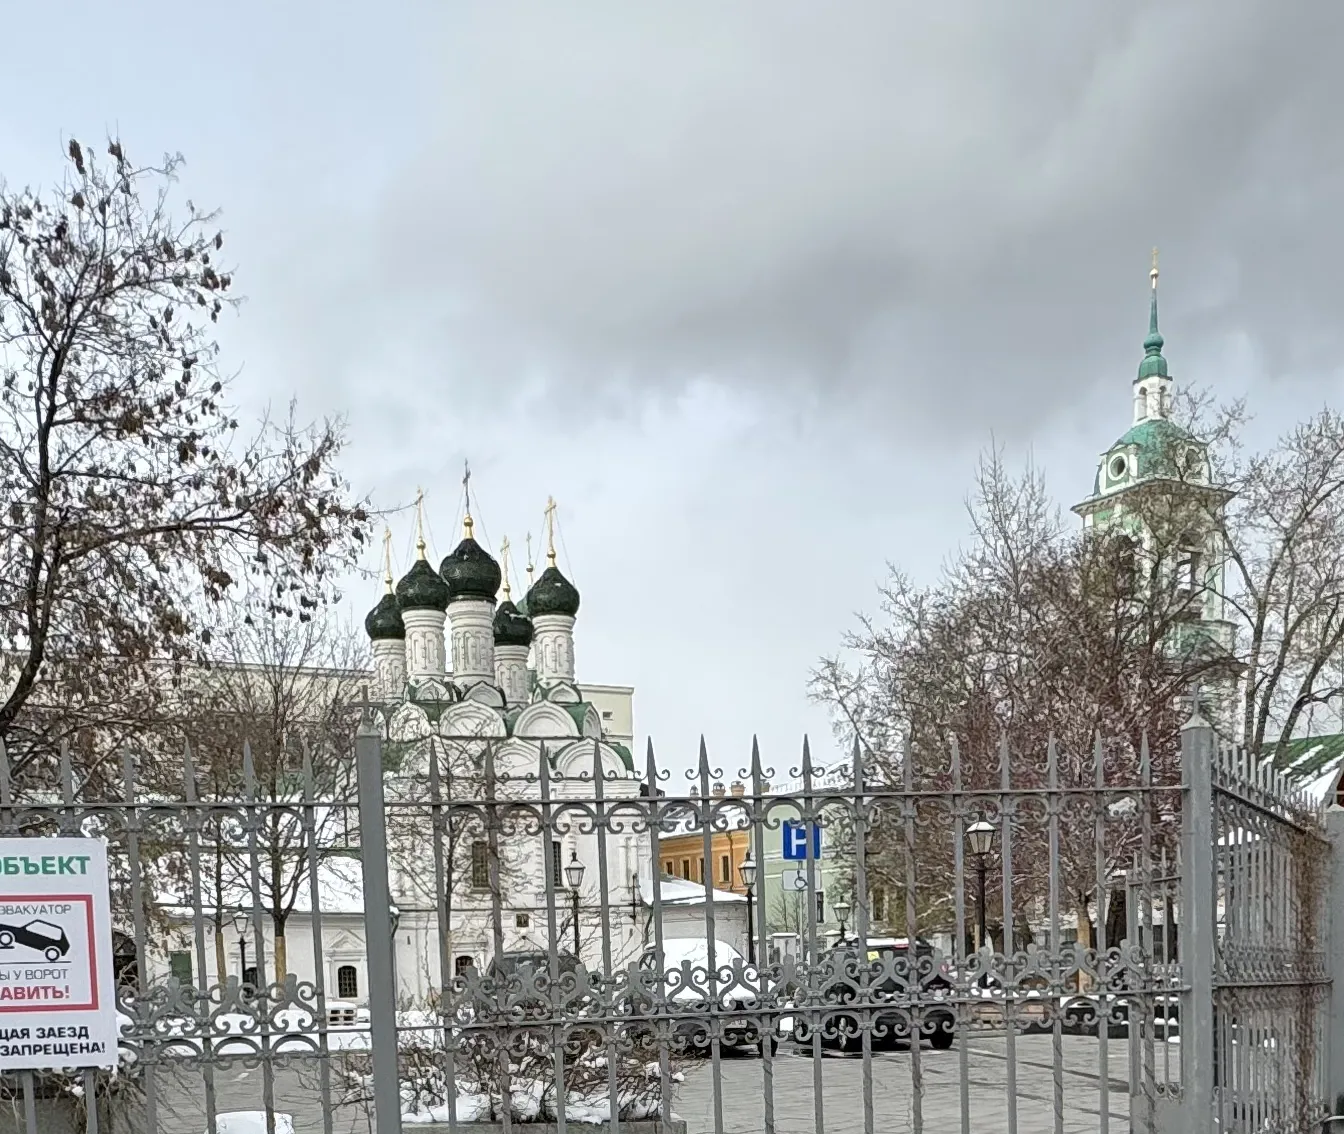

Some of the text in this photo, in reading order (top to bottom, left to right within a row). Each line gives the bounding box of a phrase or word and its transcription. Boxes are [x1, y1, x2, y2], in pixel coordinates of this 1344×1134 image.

[13, 970, 22, 981] У
[24, 968, 69, 980] ВОРОТ
[35, 1026, 90, 1040] ЗАЕЗД
[0, 1041, 106, 1057] ЗАПРЕЩЕНА!
